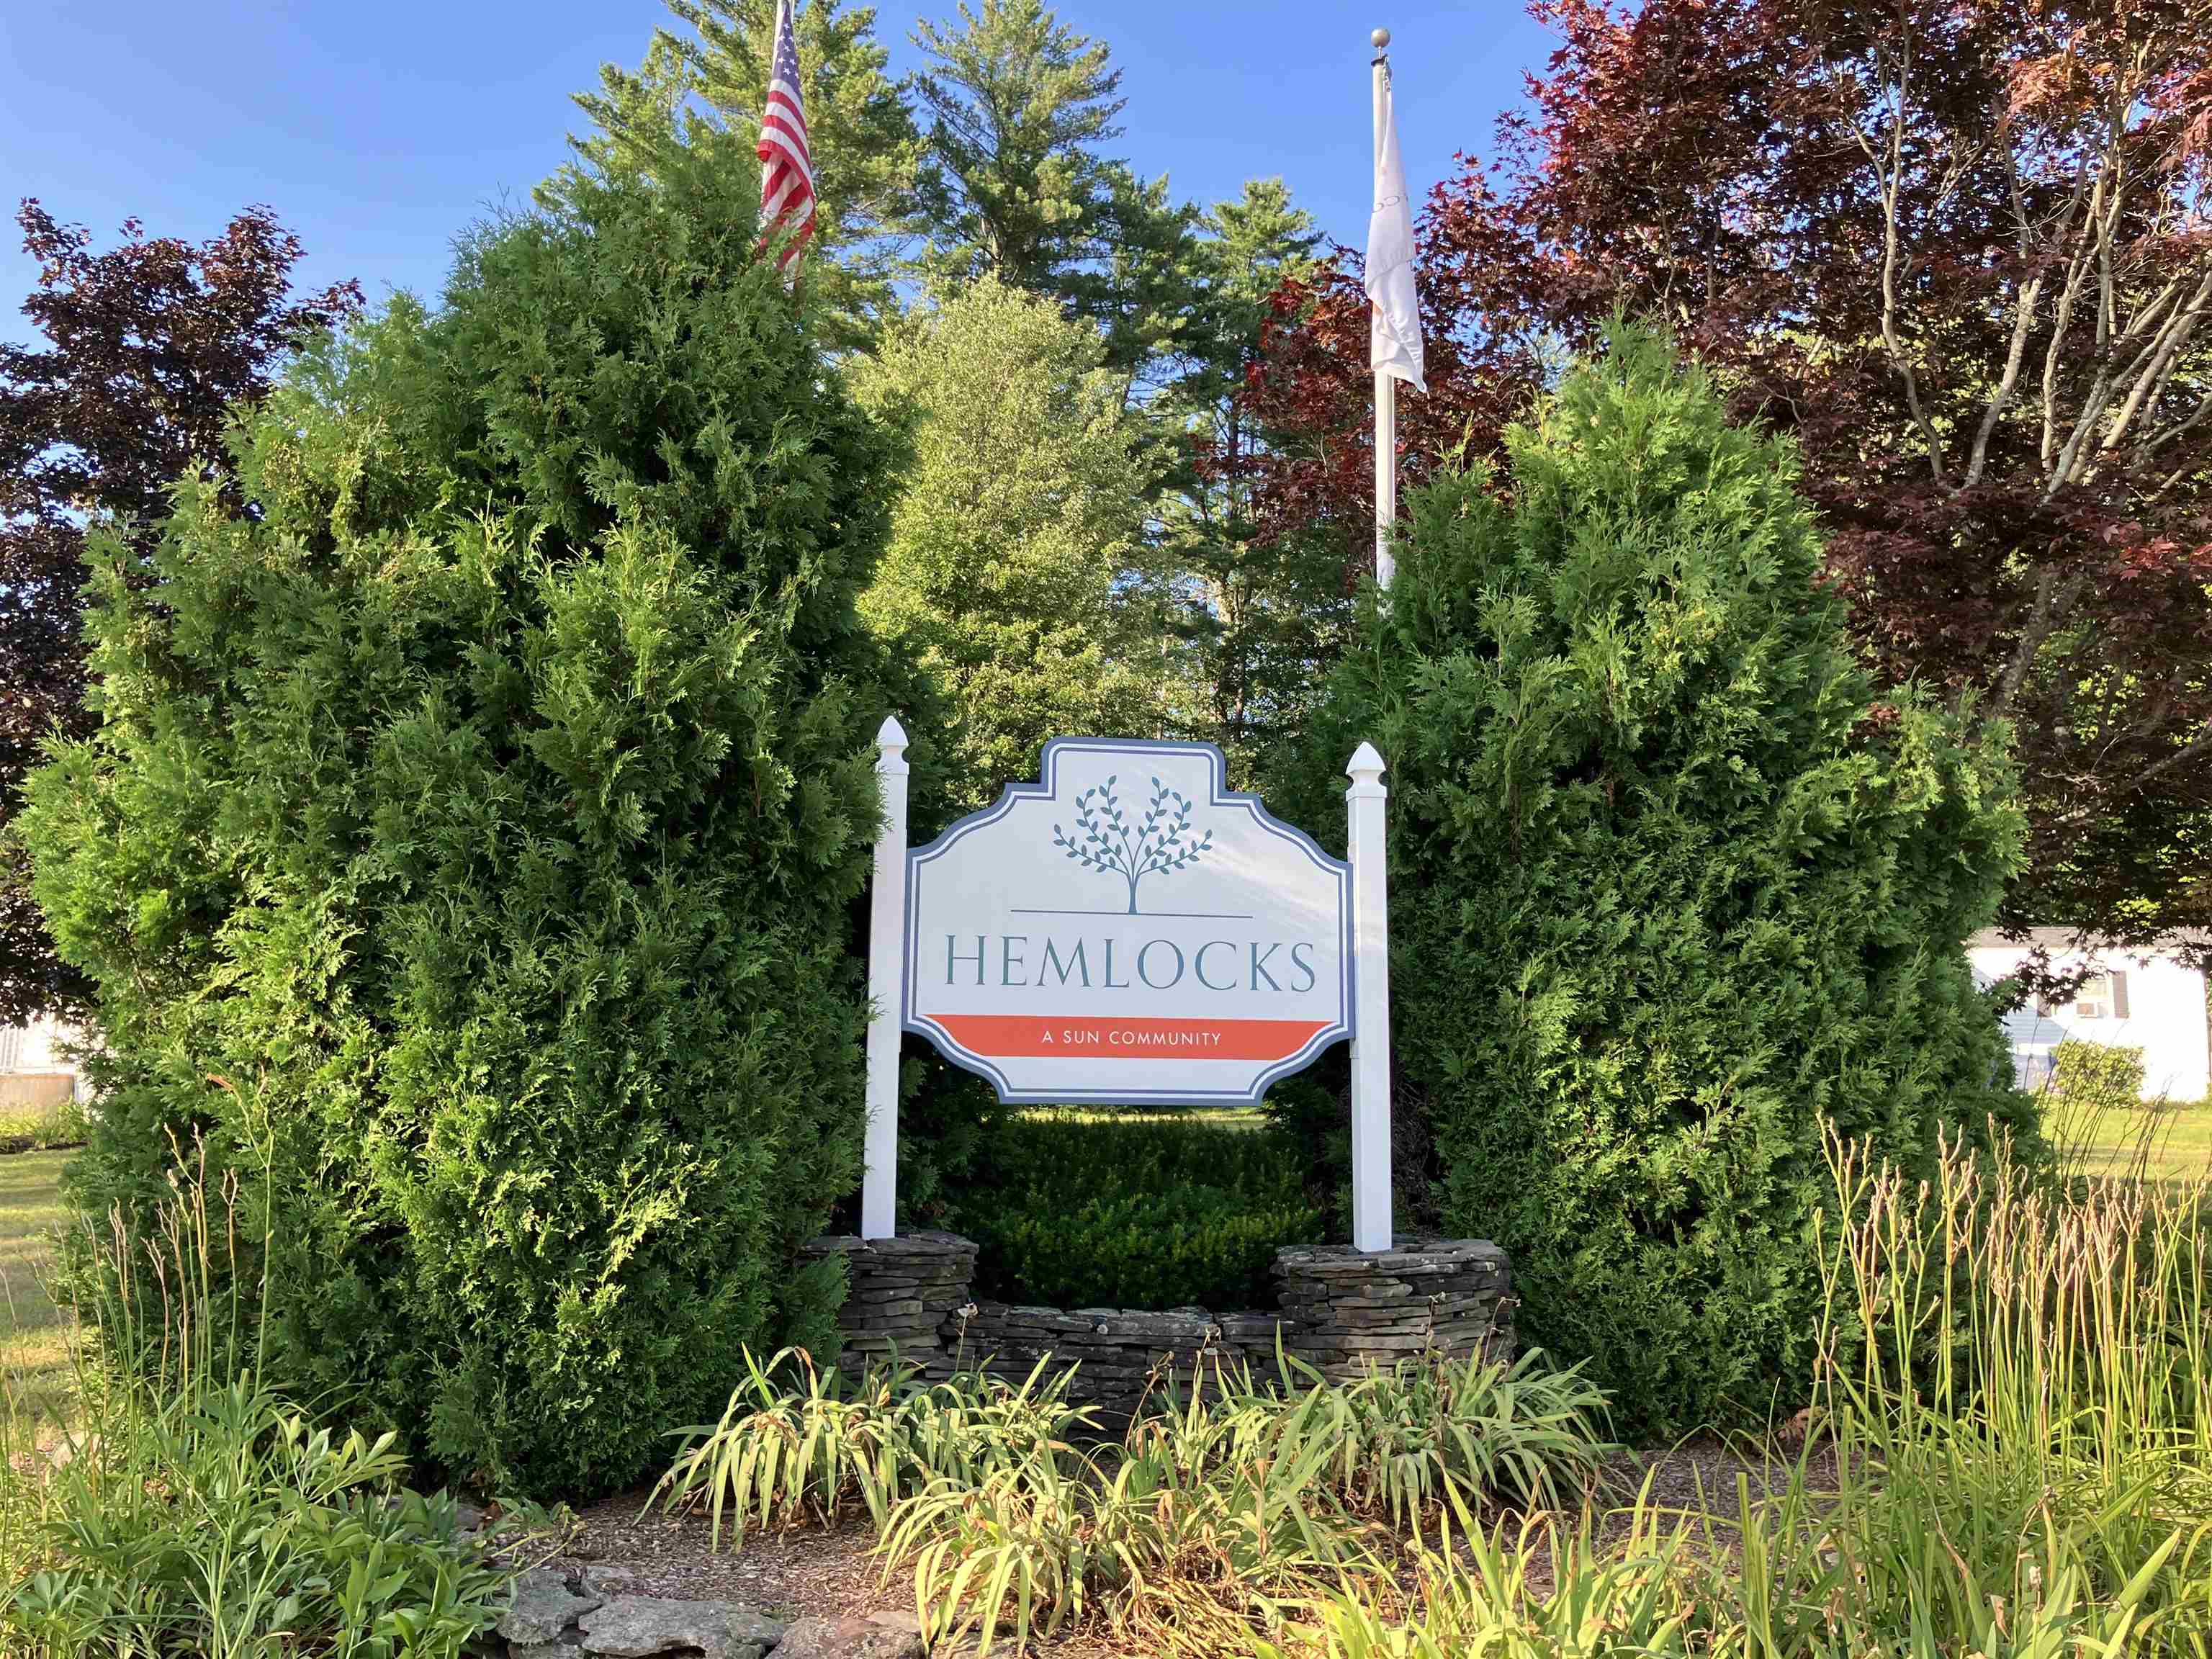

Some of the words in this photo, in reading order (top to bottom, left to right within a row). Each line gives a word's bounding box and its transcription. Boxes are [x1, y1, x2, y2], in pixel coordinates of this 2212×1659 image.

[944, 935, 1316, 993] HEMLOCKS
[1041, 1030, 1054, 1044] A
[1063, 1030, 1100, 1044] SUN
[1109, 1030, 1222, 1046] COMMUNITY
